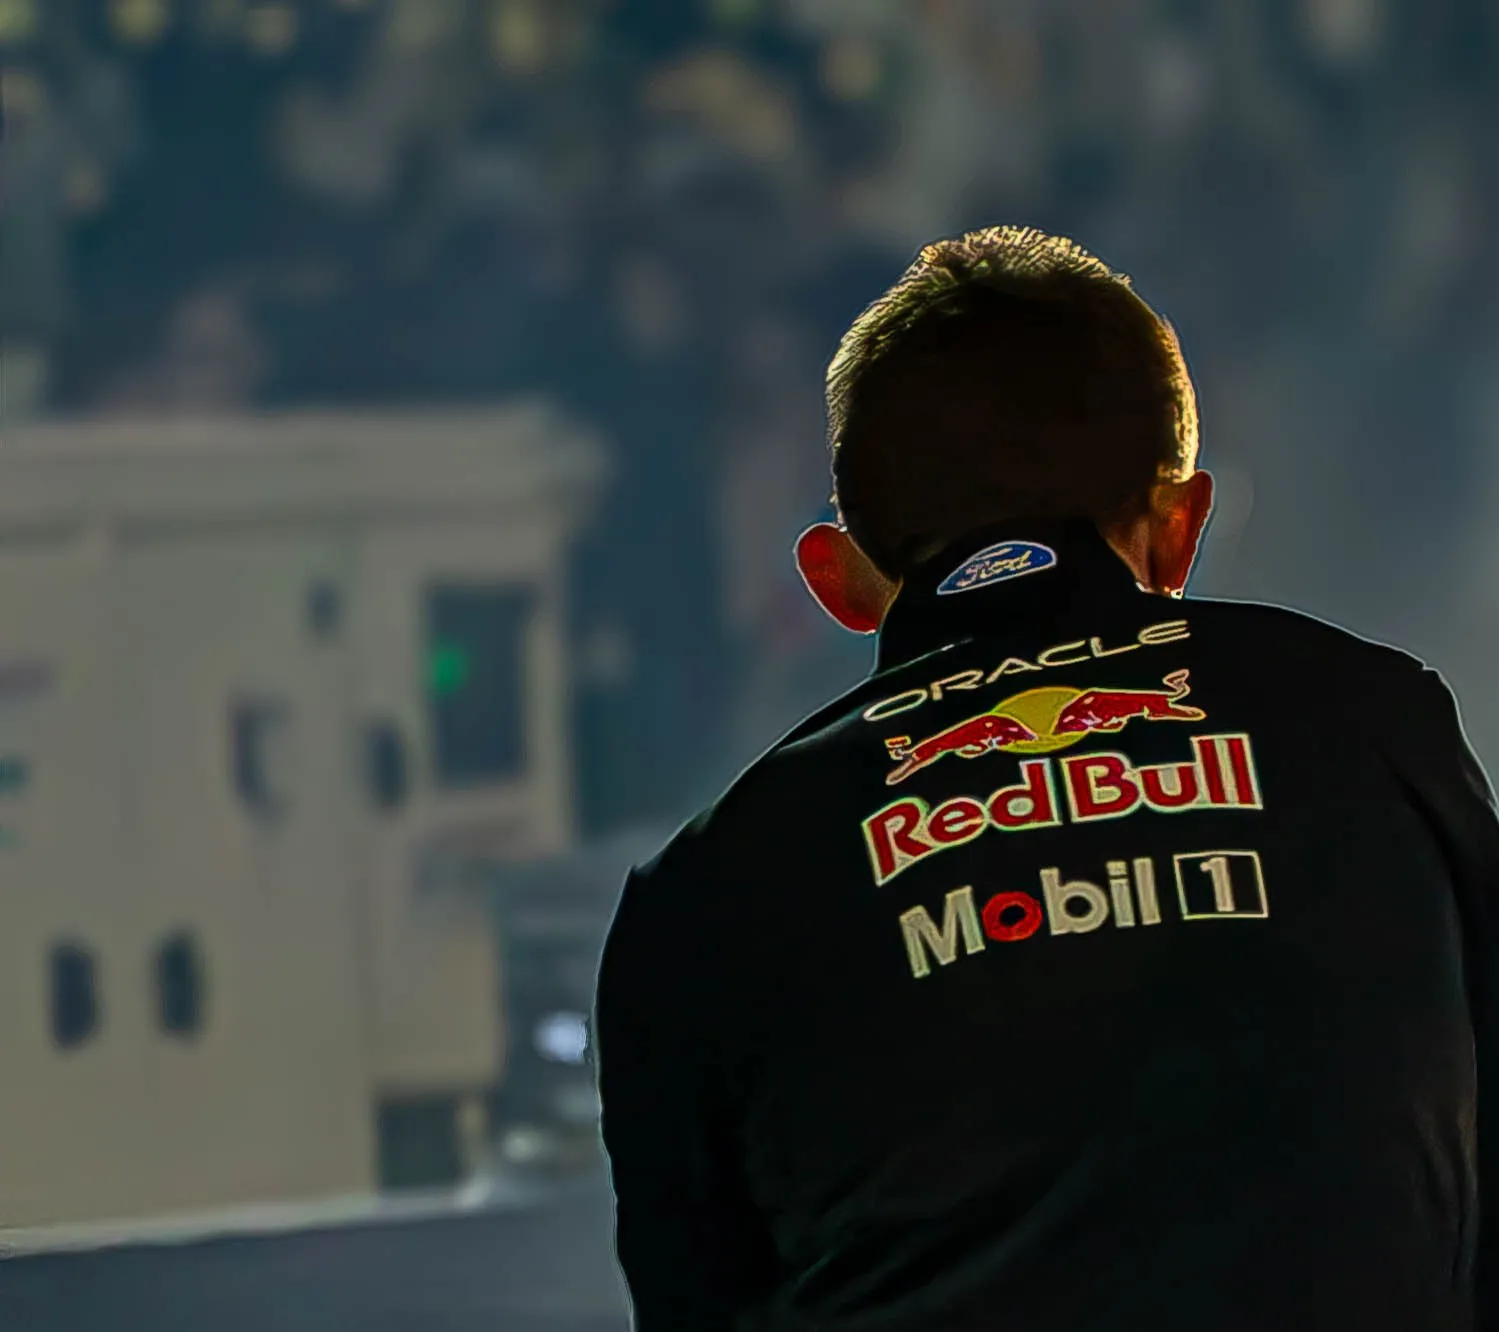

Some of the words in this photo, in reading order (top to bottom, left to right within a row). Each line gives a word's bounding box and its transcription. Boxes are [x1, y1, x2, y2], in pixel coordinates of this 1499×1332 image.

[864, 619, 1191, 721] ORACLE
[862, 758, 1062, 886] Red
[1060, 733, 1263, 822] Bull
[900, 857, 1161, 978] Mobil
